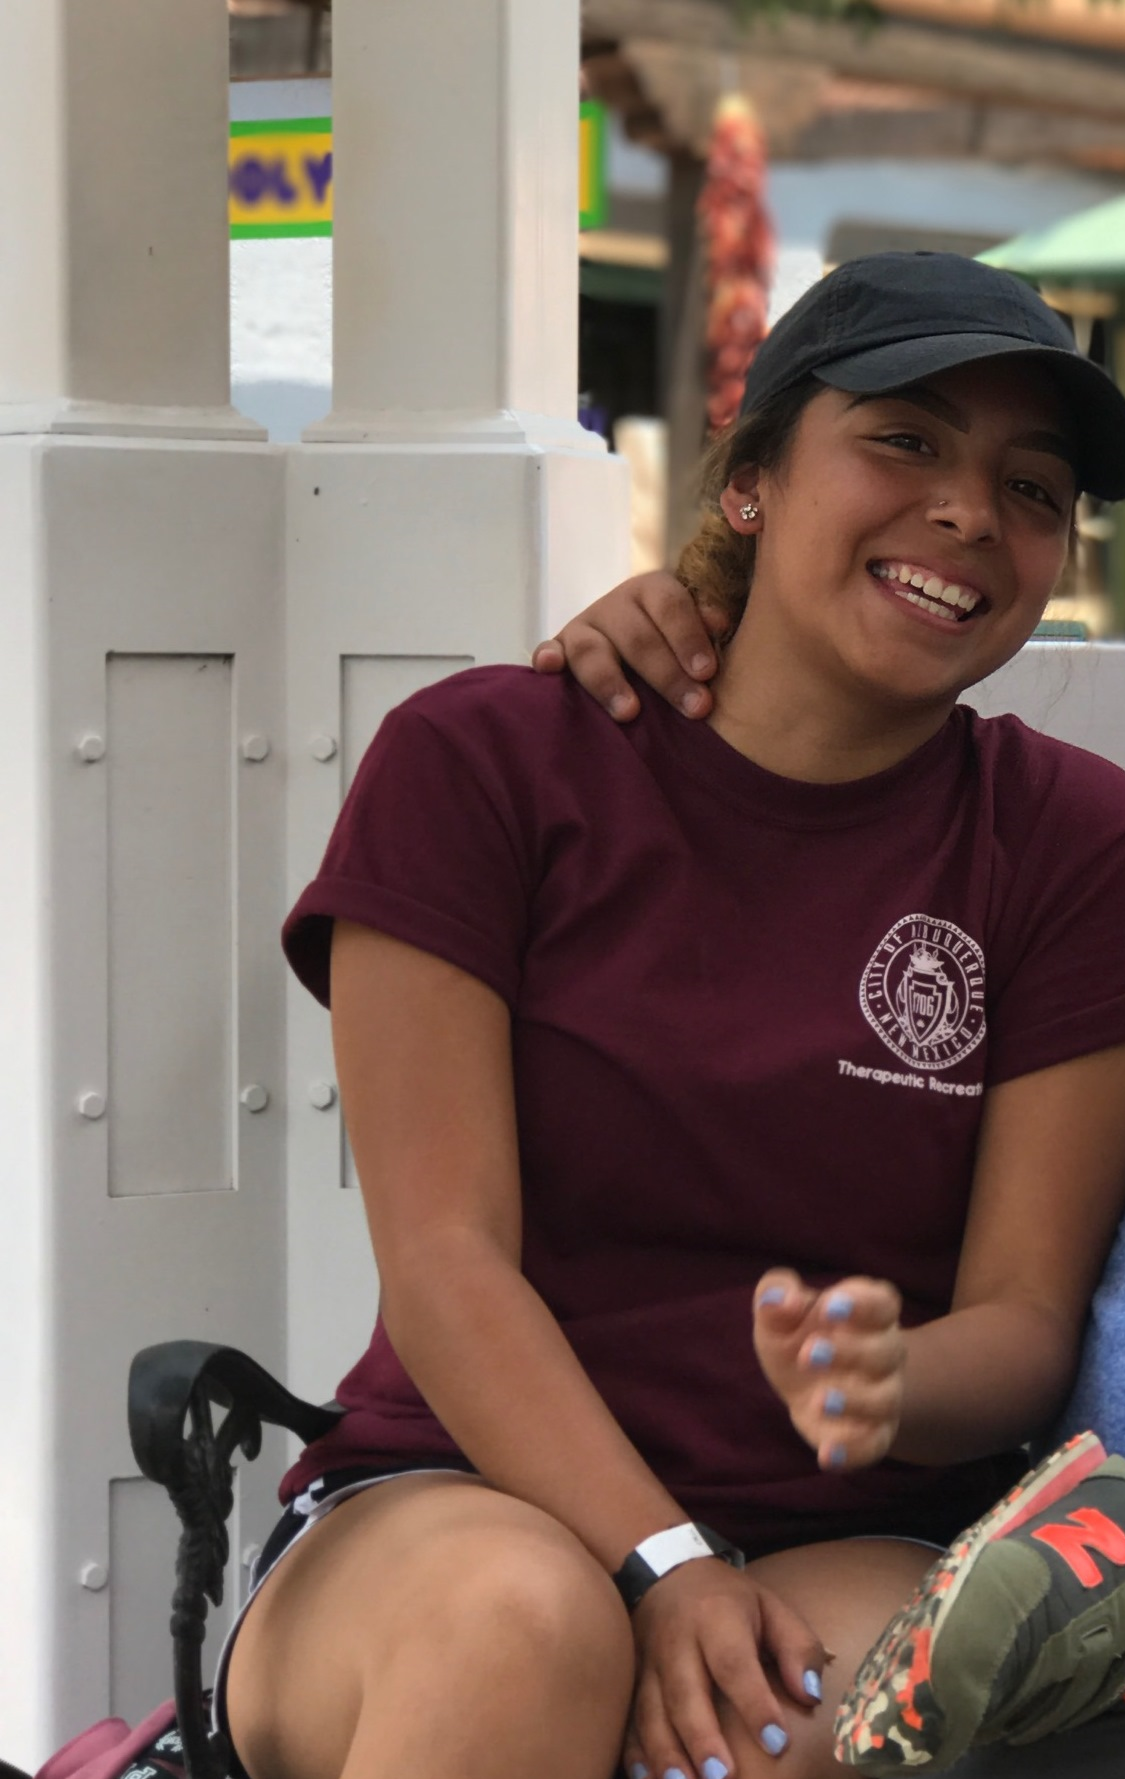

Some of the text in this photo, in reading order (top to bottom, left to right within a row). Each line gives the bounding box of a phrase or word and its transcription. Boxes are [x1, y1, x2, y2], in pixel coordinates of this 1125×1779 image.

[868, 961, 886, 999] CITY
[884, 933, 903, 953] OF
[879, 1012, 973, 1060] NEW MEXICO
[838, 1060, 925, 1088] Therapeutic
